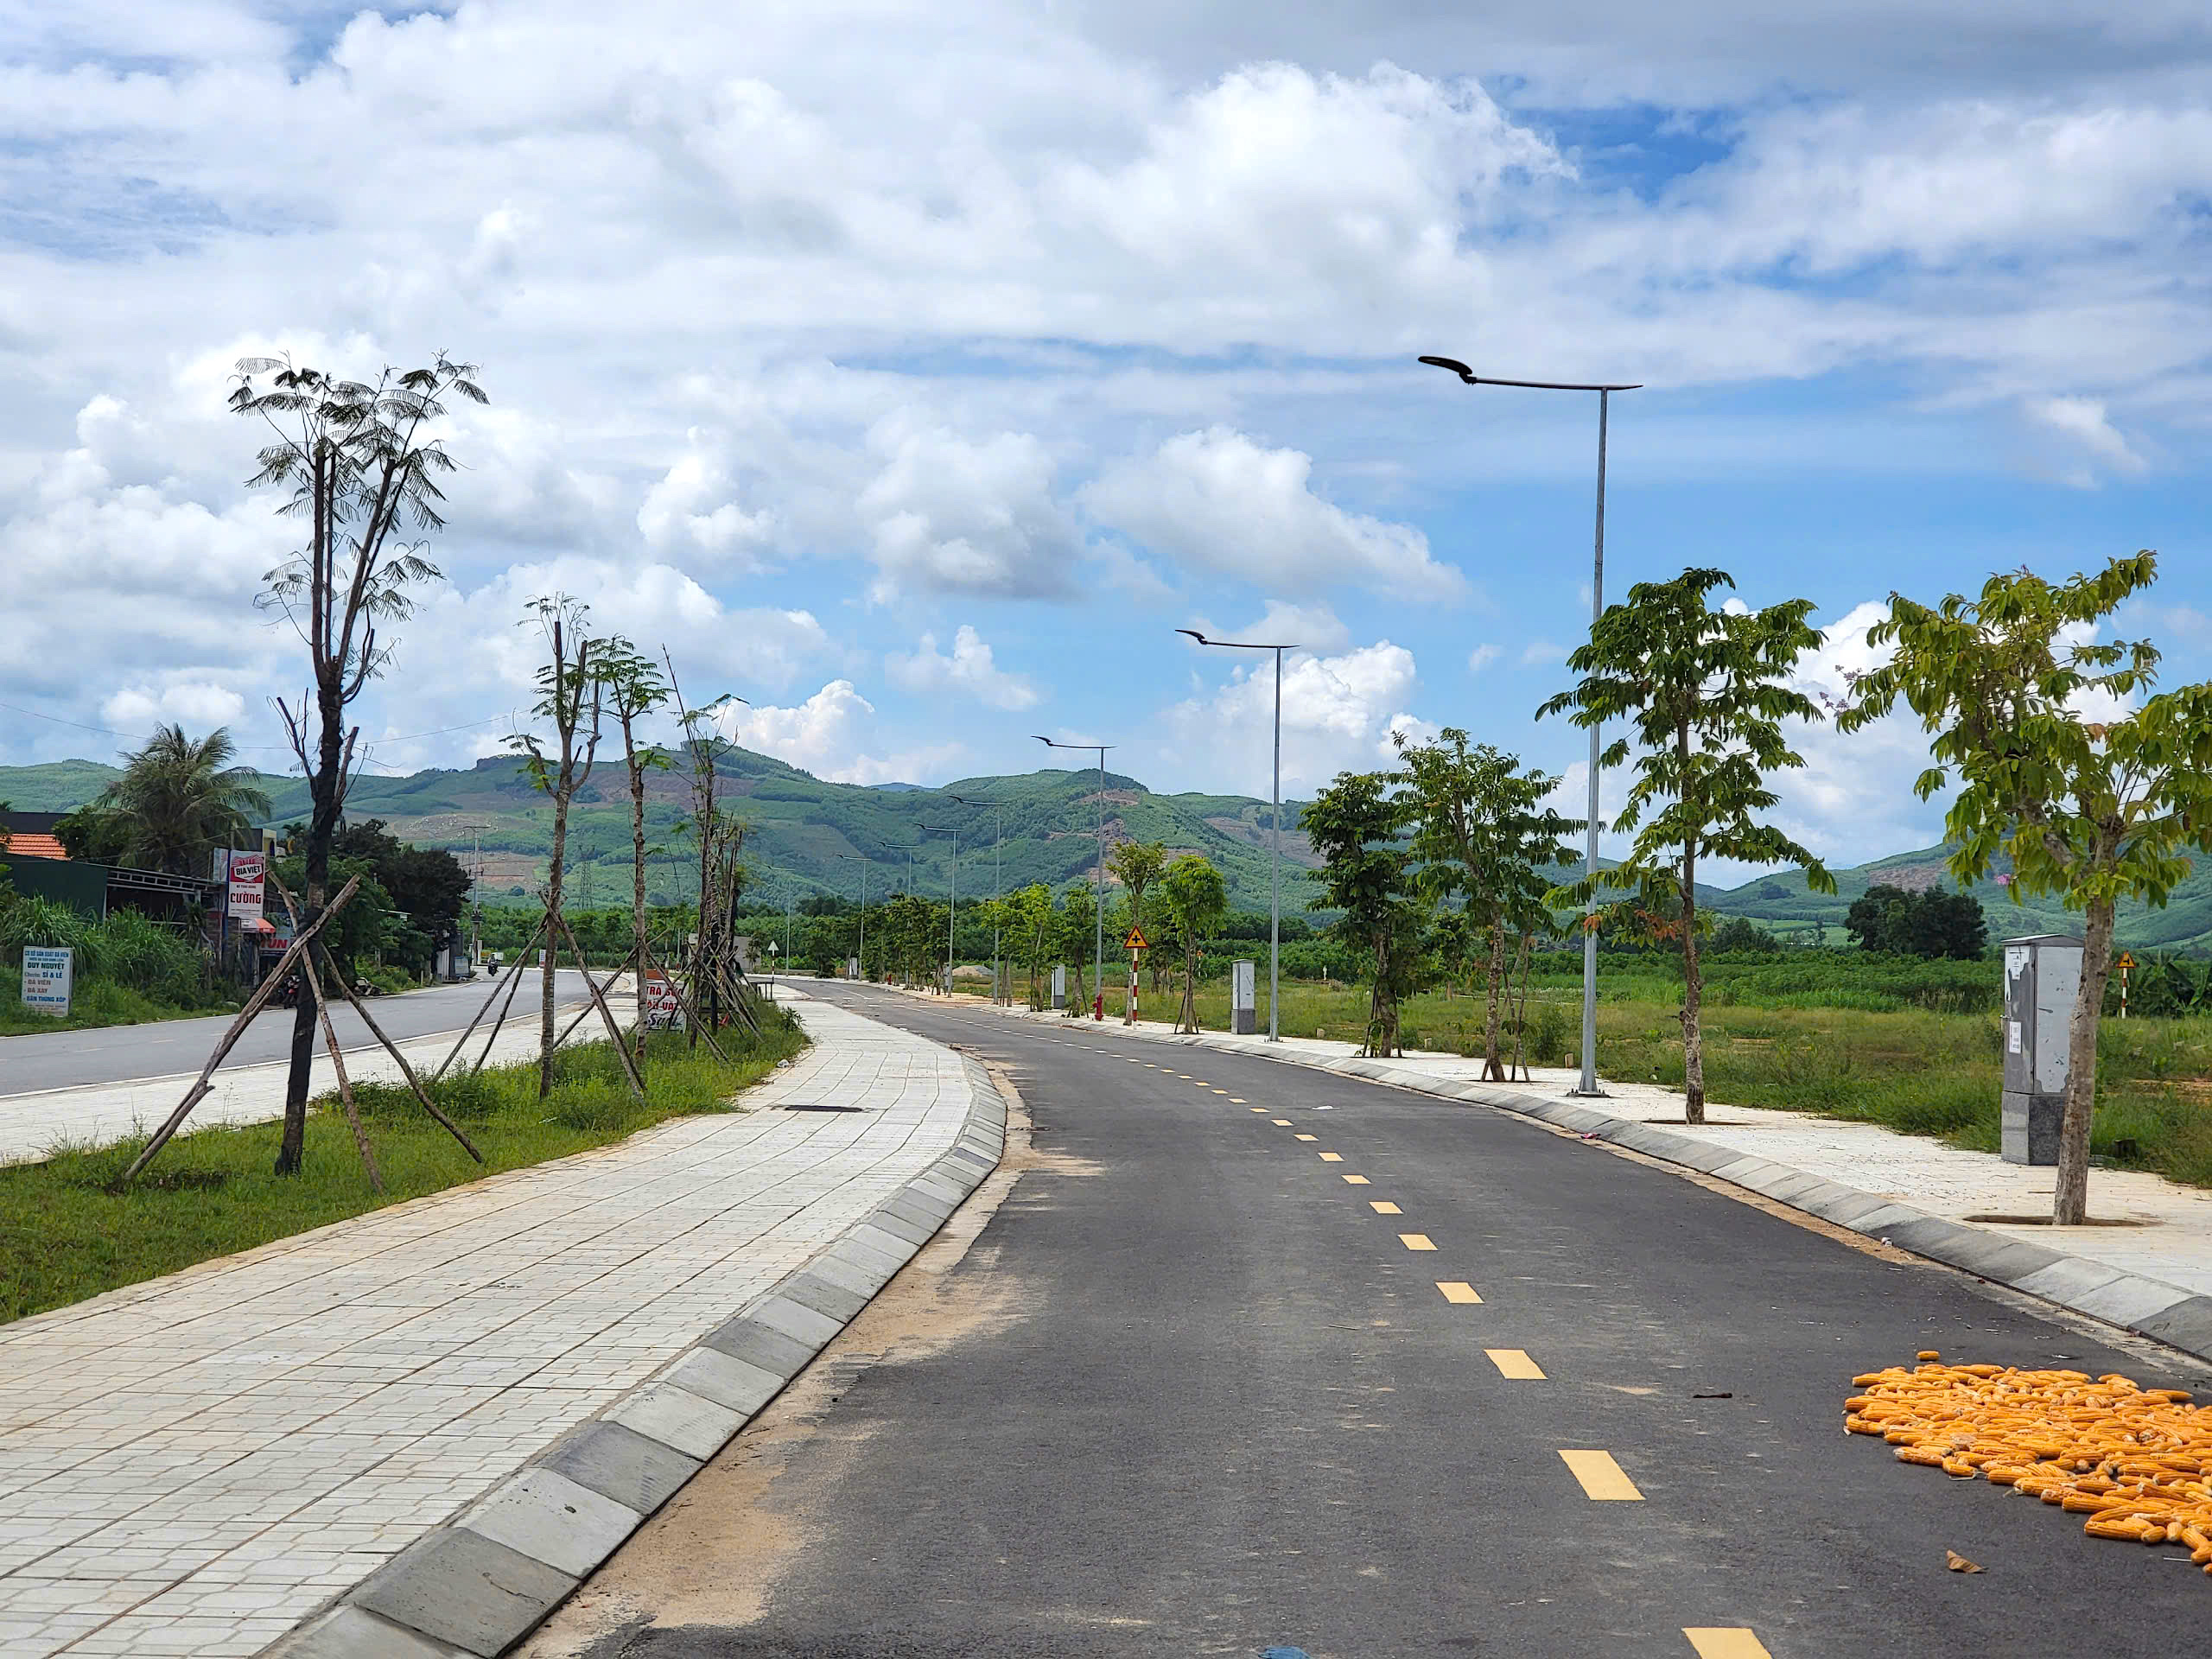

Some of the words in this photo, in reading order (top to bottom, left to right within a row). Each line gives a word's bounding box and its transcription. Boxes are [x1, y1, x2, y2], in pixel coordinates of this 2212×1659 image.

[236, 867, 247, 875] BIA
[247, 865, 260, 874] VIỆT
[230, 891, 261, 904] CƯỜNG
